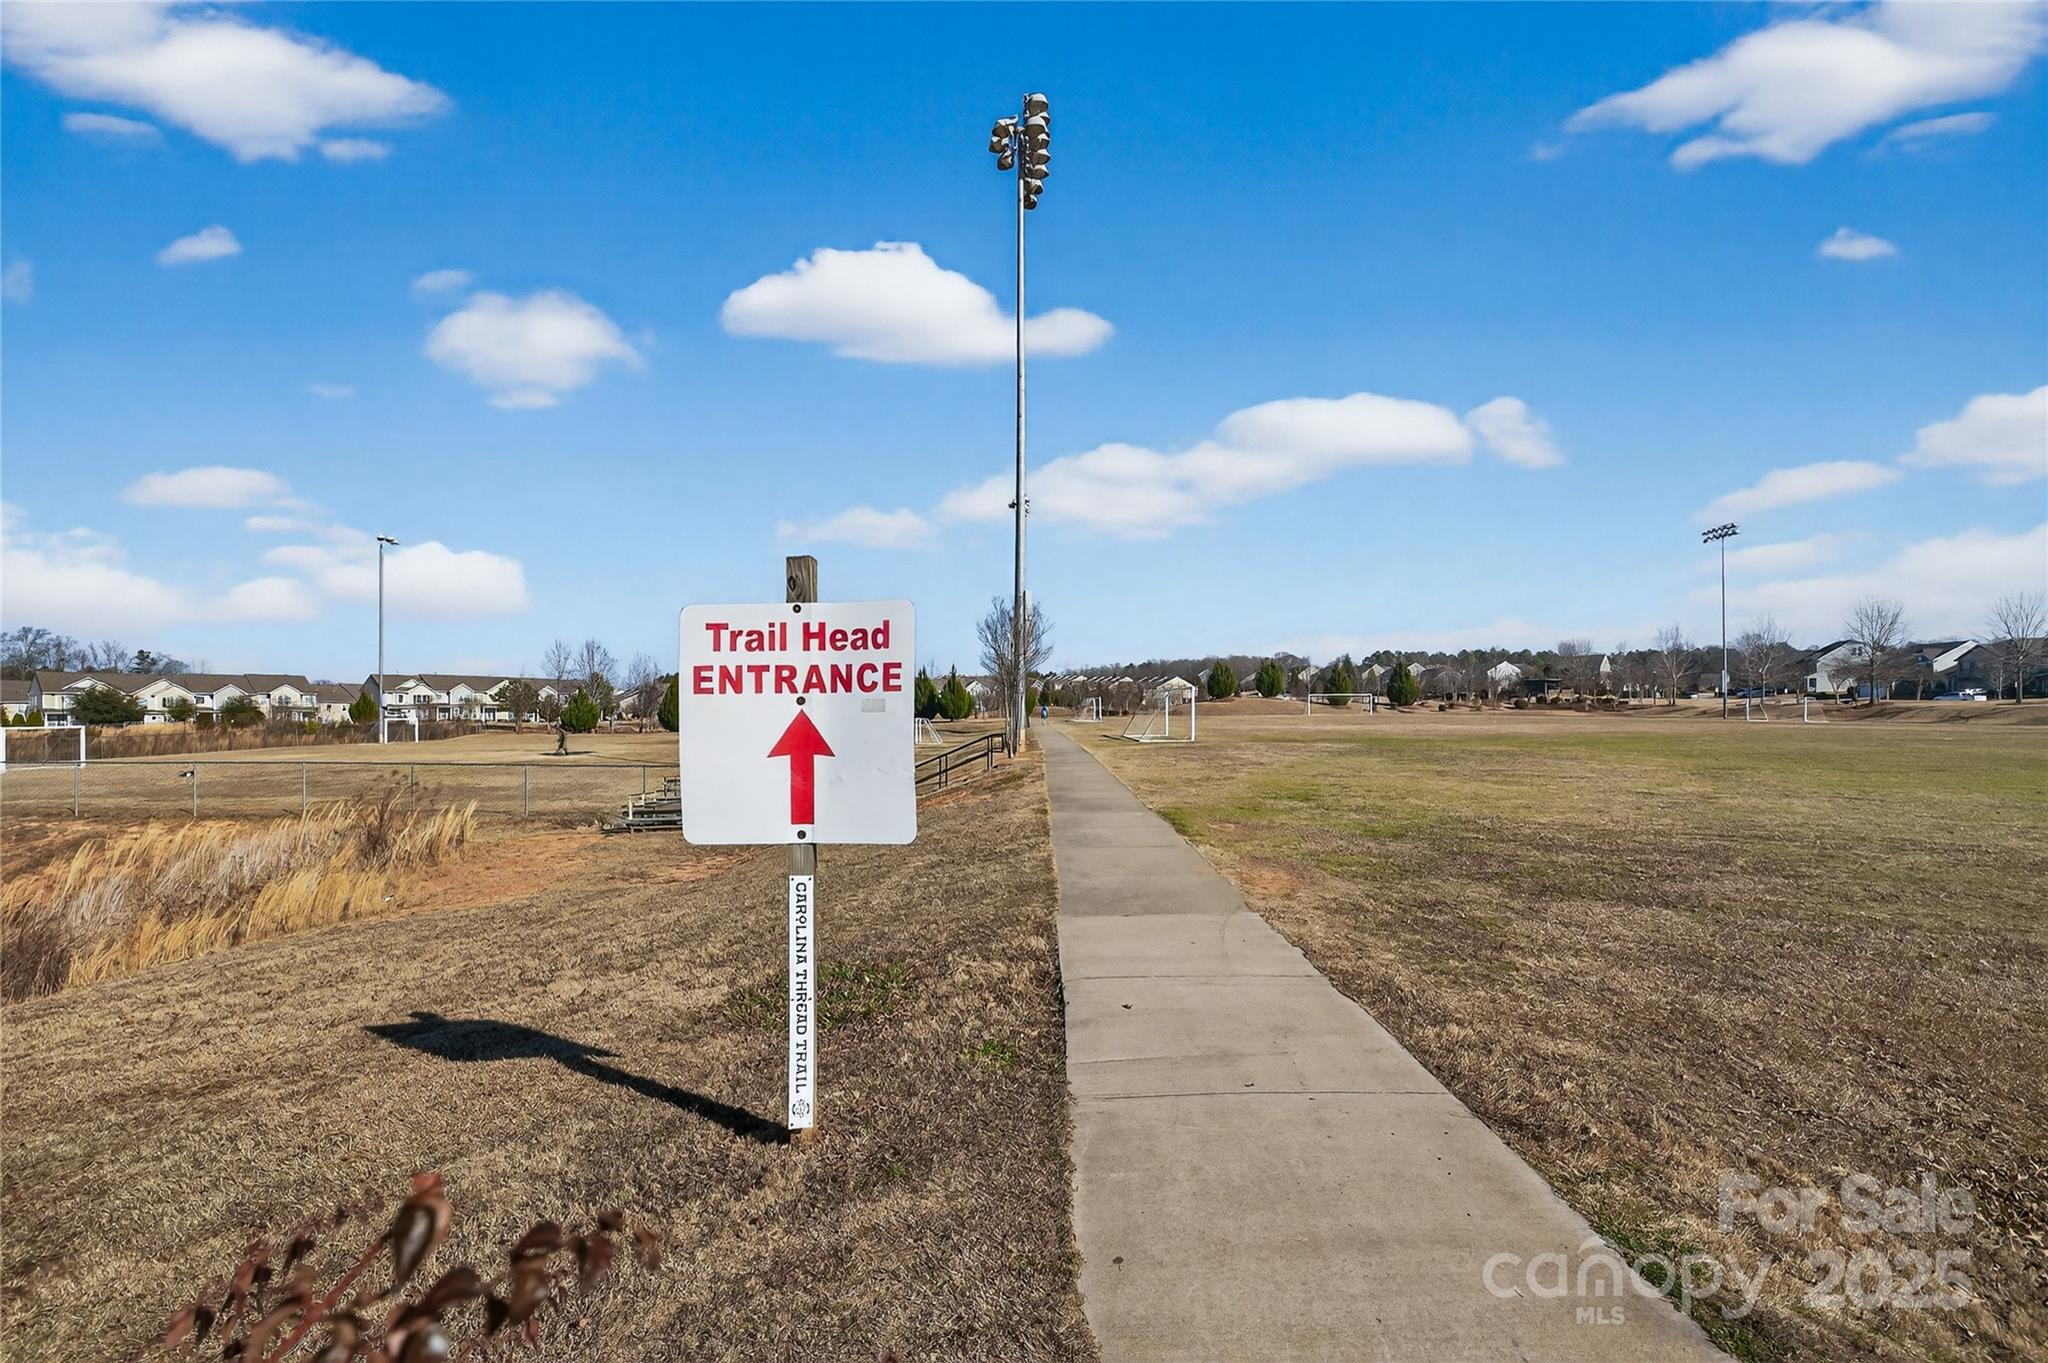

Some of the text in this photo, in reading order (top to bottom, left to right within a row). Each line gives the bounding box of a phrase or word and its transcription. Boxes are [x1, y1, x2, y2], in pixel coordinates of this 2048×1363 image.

[705, 619, 890, 652] Trail Head
[692, 662, 902, 695] ENTRANCE
[795, 882, 808, 1094] CAROLINA THREAD TRAIL
